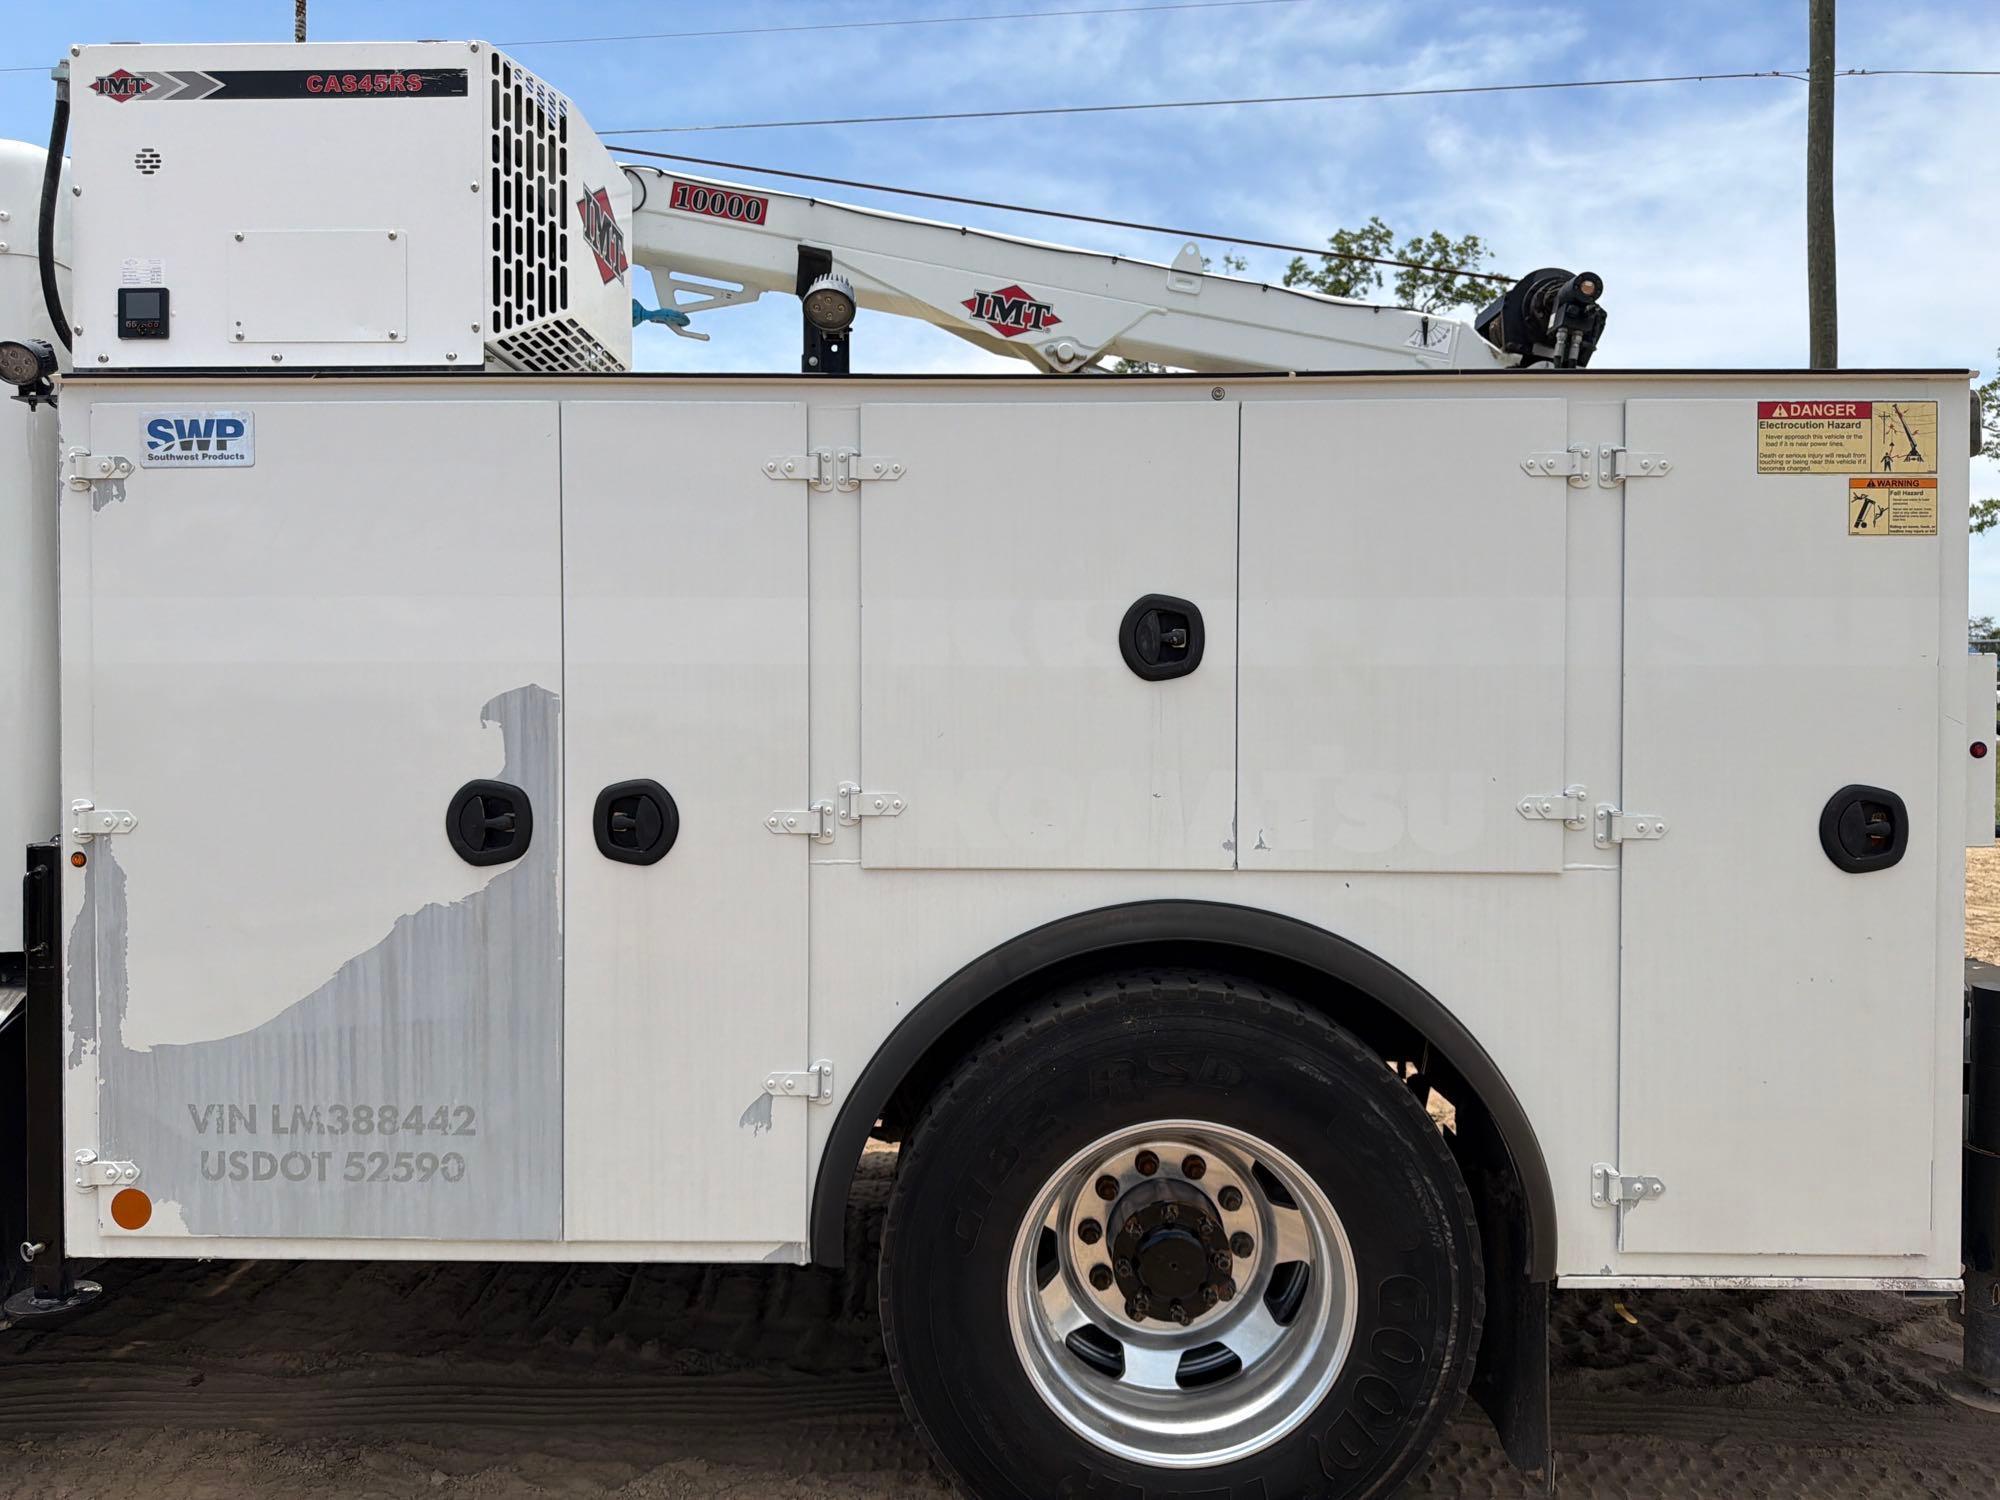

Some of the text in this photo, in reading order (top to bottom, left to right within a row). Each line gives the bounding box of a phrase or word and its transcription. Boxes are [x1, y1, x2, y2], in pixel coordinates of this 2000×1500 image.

[95, 74, 148, 97] IMT
[306, 73, 423, 93] CAS45RS
[675, 185, 763, 223] 10000
[583, 182, 625, 287] IMT
[970, 288, 1053, 332] IMT
[1759, 421, 1861, 429] Electrocution Hazard
[1790, 404, 1856, 416] DANGER
[147, 418, 245, 452] SWP
[147, 452, 245, 461] Southwest Products
[187, 1104, 477, 1136] VIN LM388442
[200, 1151, 466, 1183] USDOT 52590
